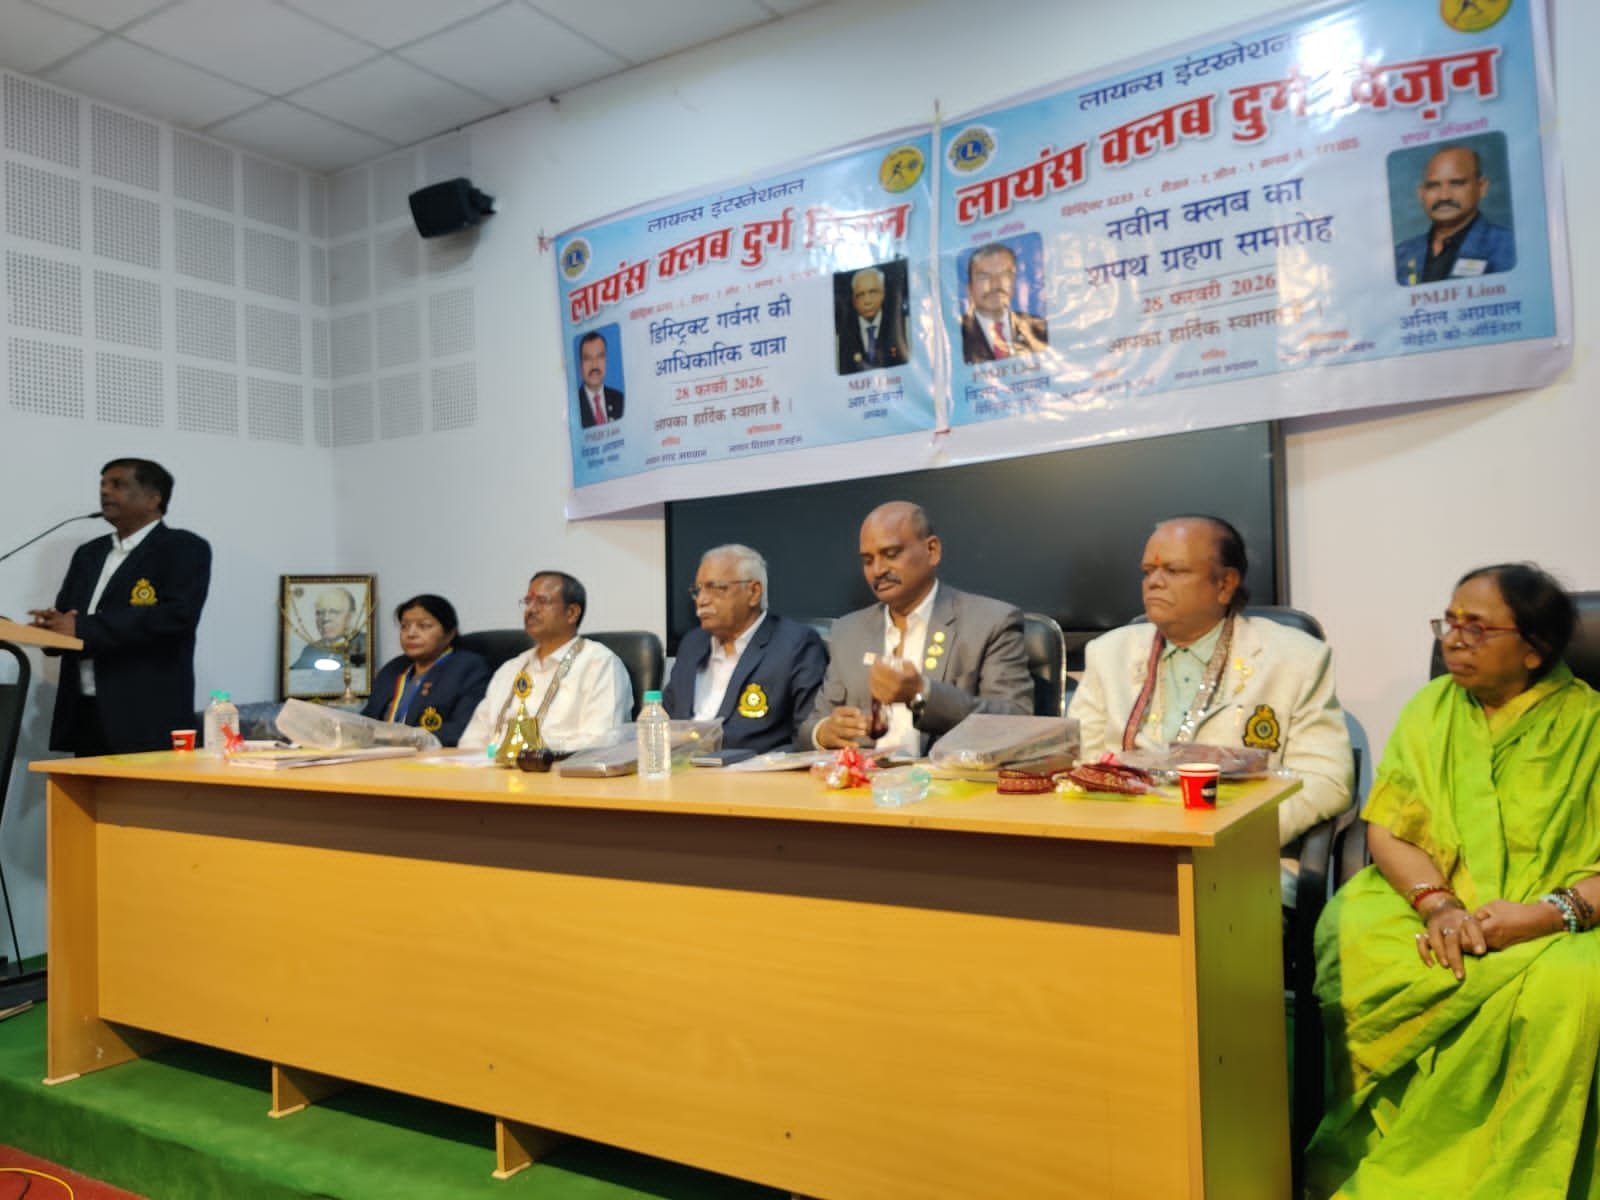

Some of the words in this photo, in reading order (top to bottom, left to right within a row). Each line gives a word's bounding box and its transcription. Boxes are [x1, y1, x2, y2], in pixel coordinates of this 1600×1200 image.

[1078, 70, 1164, 111] लायन्स
[1173, 34, 1303, 85] इंटरनेशन
[956, 145, 1087, 222] लायंस
[1099, 94, 1215, 164] क्लब
[1106, 206, 1170, 241] नवीन
[1182, 190, 1250, 224] क्लब
[1262, 177, 1304, 205] का
[568, 261, 649, 322] लायंस
[658, 228, 733, 278] क्लब
[741, 207, 795, 267] दुर्ग
[1086, 255, 1149, 288] शपथ
[1161, 238, 1224, 272] ग्रहण
[1235, 212, 1334, 256] समारोह
[1232, 273, 1276, 297] 2026
[768, 292, 792, 318] की
[750, 336, 787, 357] यात्रा
